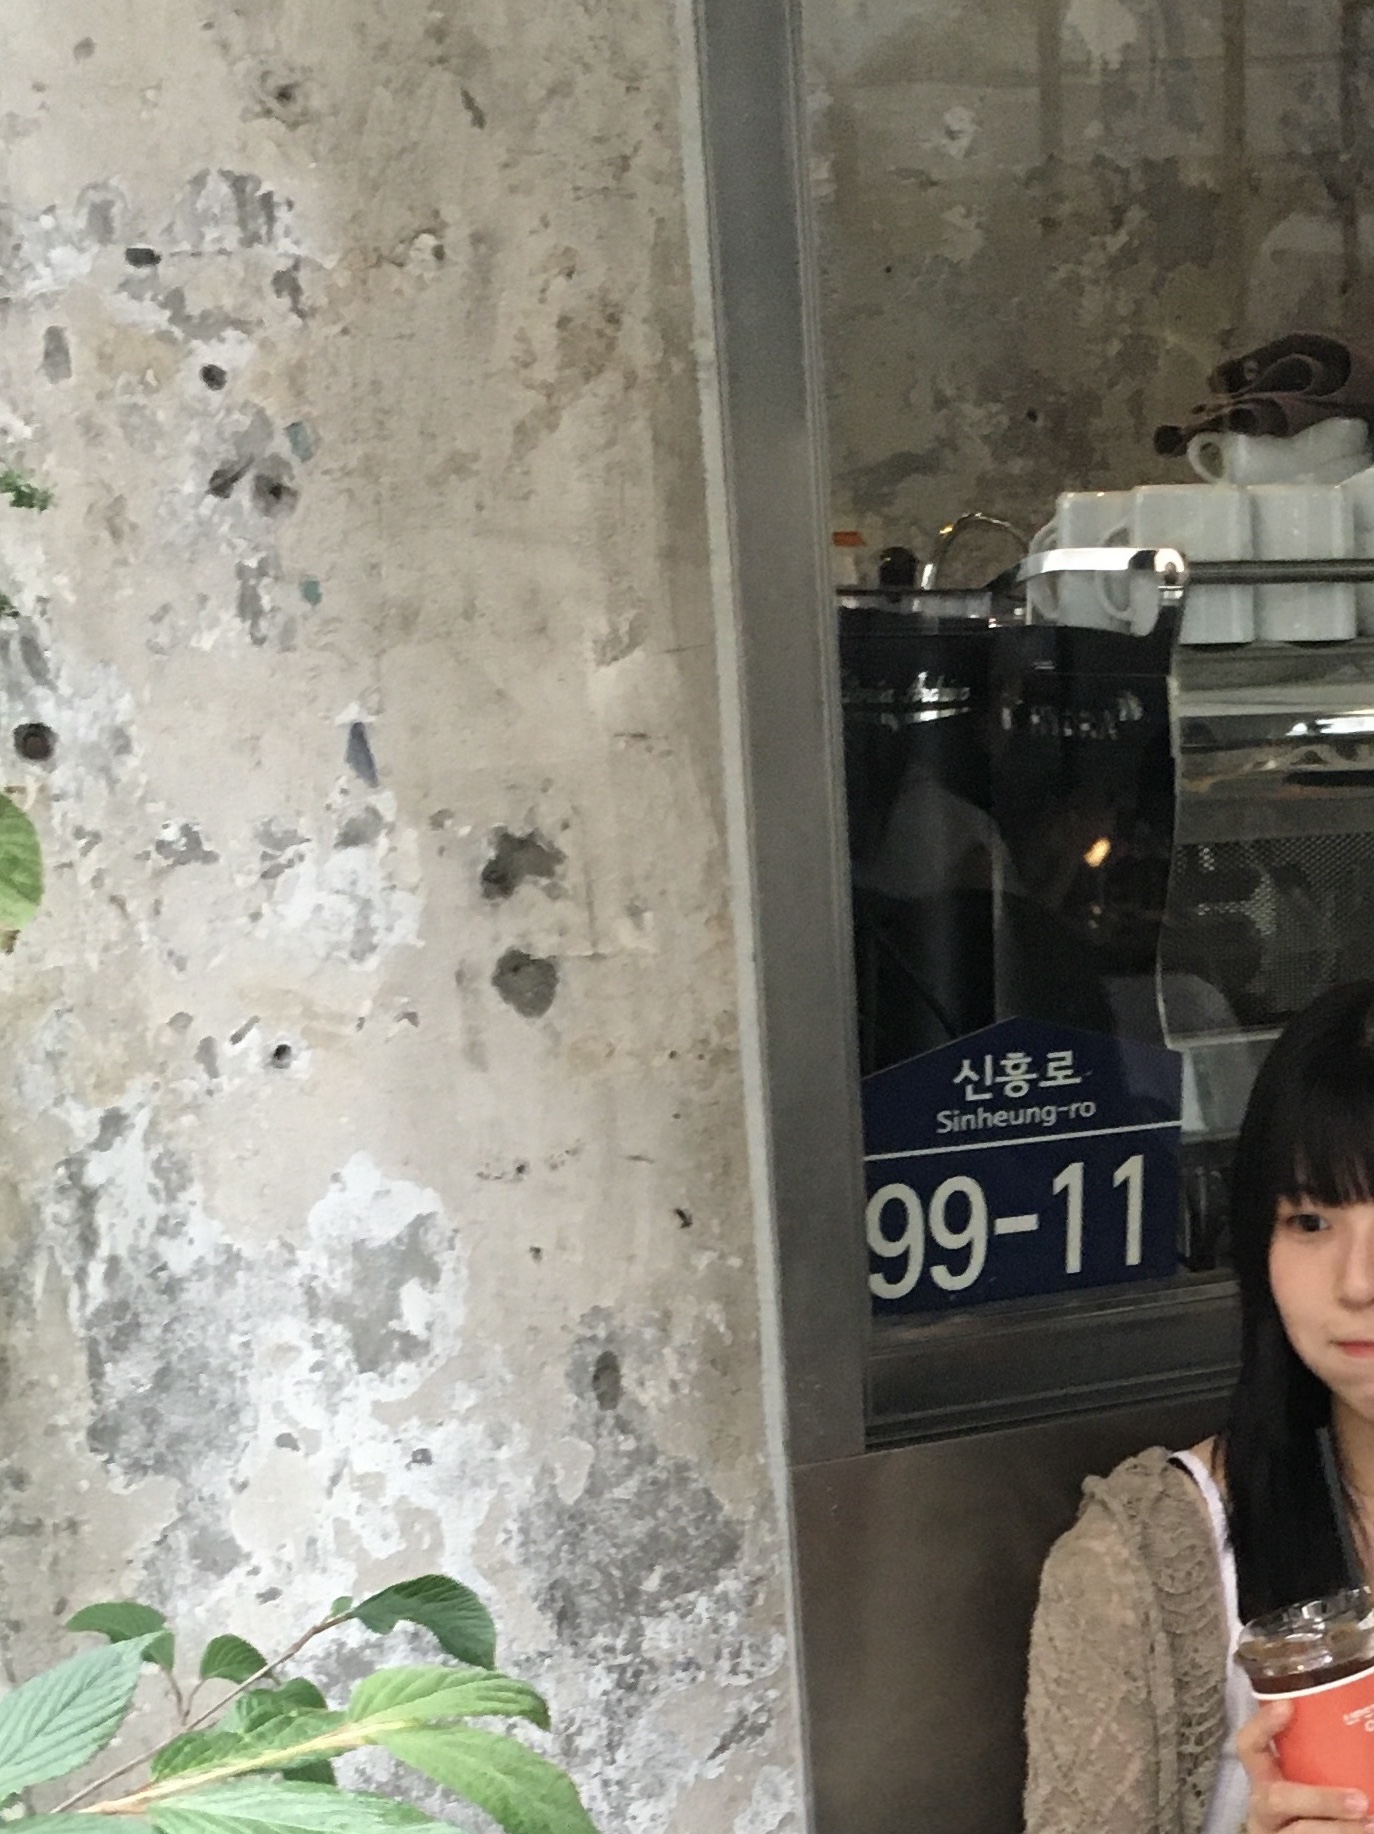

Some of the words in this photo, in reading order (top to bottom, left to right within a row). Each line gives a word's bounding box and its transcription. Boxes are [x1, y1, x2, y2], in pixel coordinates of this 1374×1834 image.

[953, 1050, 1083, 1101] 신흥로
[936, 1101, 1097, 1134] Sinheung-ro
[866, 1154, 1145, 1300] 99-11
